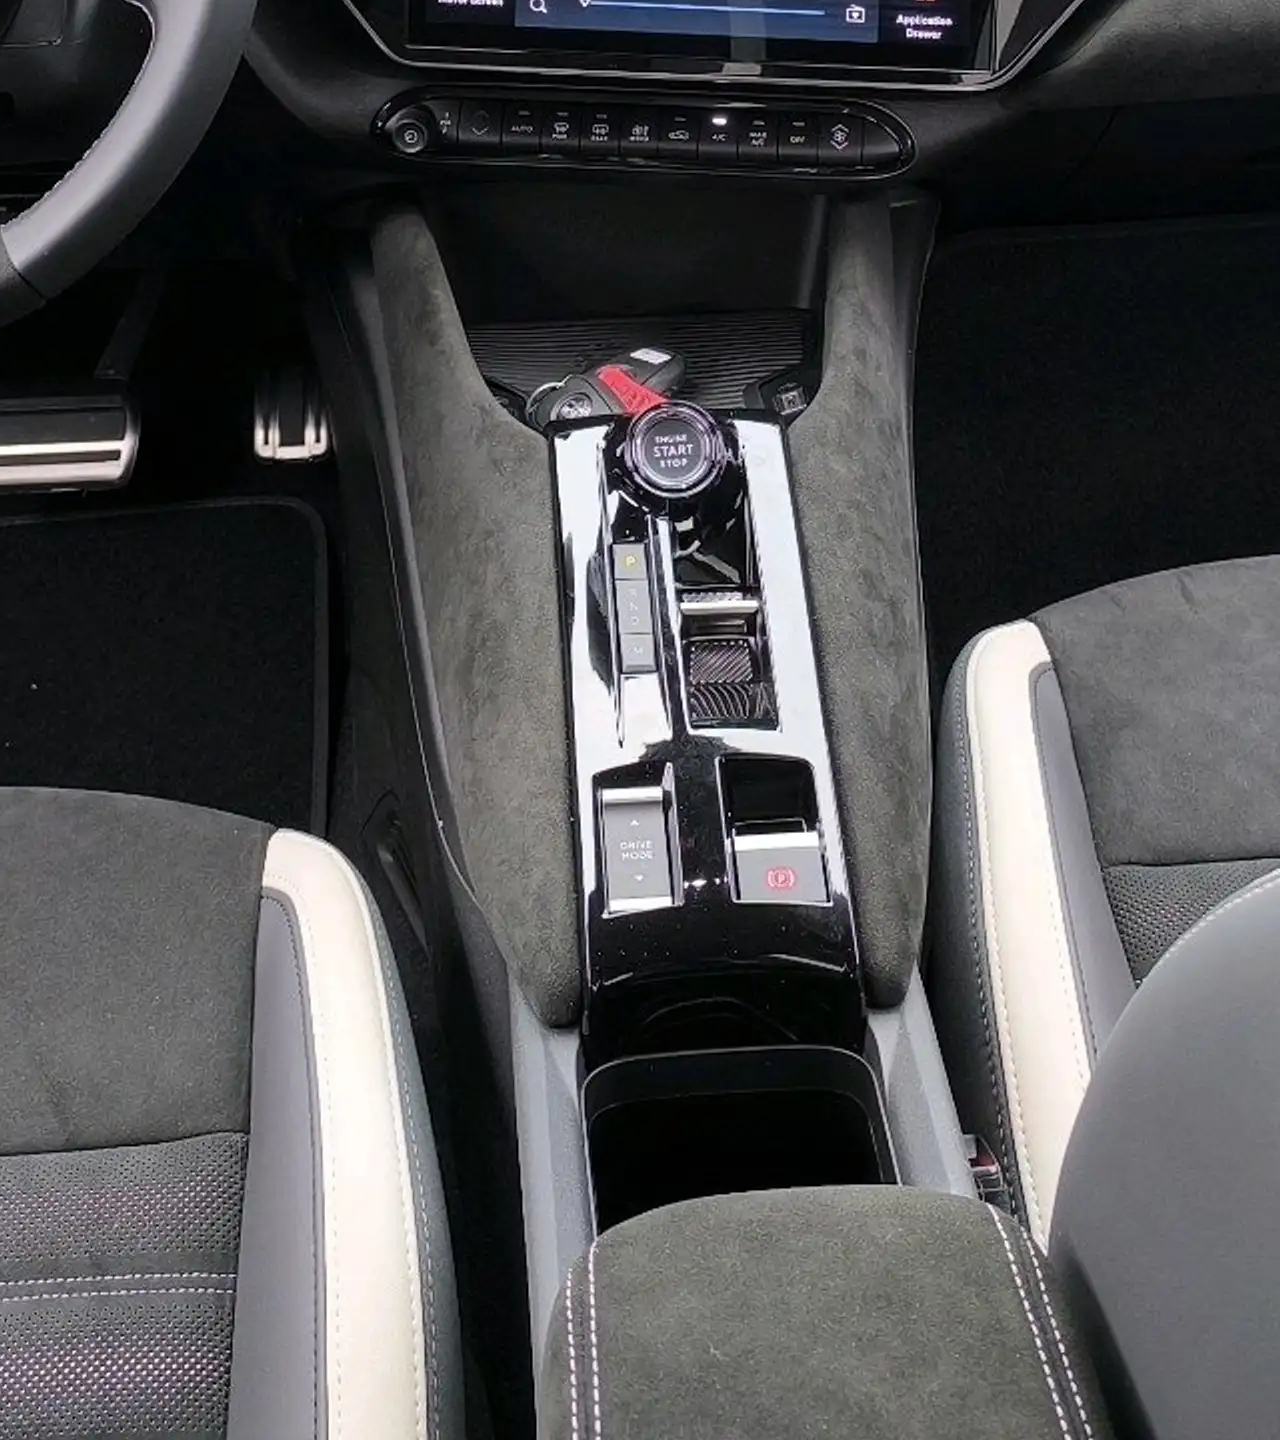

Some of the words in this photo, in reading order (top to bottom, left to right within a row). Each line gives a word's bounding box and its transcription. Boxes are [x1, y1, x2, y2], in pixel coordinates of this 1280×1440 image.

[896, 14, 953, 27] Application
[906, 28, 942, 40] Drawer
[510, 125, 533, 134] AUTO
[655, 434, 688, 444] ENGINE
[653, 443, 694, 458] START
[660, 458, 688, 468] STOP
[625, 554, 637, 567] P
[620, 839, 652, 850] DRIVE
[622, 850, 652, 861] MODE
